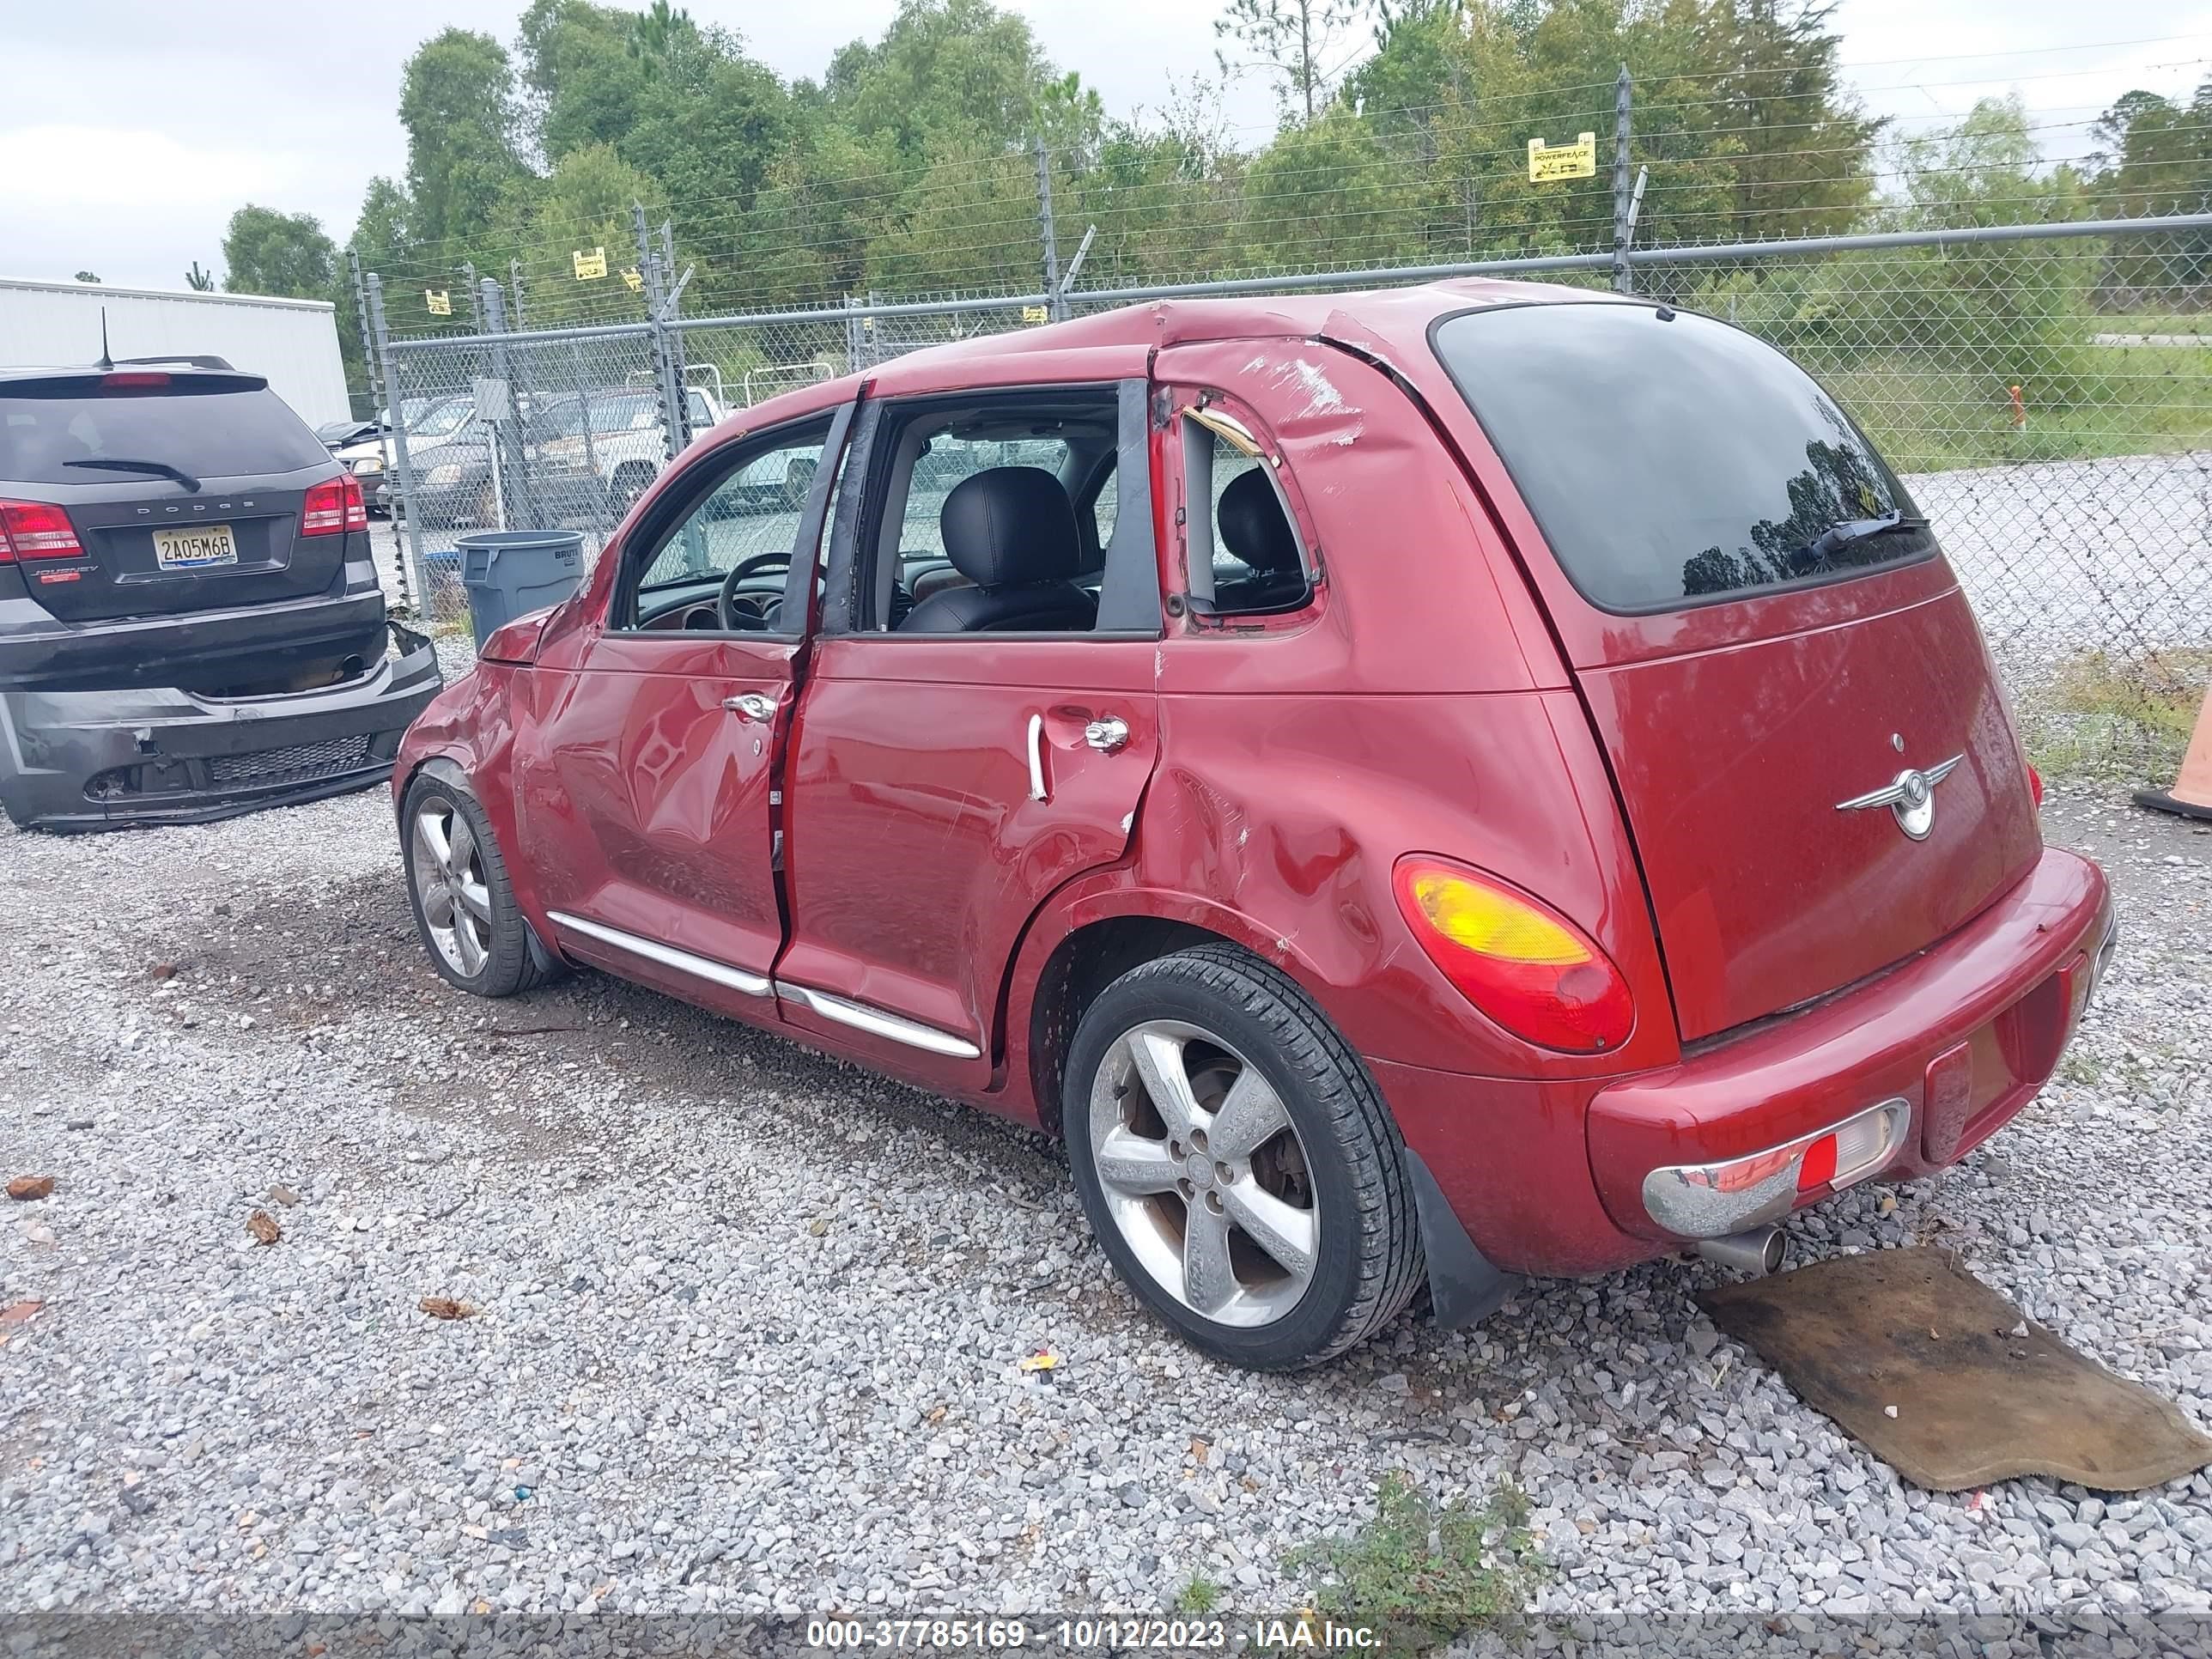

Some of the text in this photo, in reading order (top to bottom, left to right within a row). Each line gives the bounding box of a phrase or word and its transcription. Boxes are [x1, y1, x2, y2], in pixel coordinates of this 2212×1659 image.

[137, 501, 254, 514] DODGE
[161, 536, 230, 561] 2A05M6B
[30, 565, 99, 576] JOURNEY
